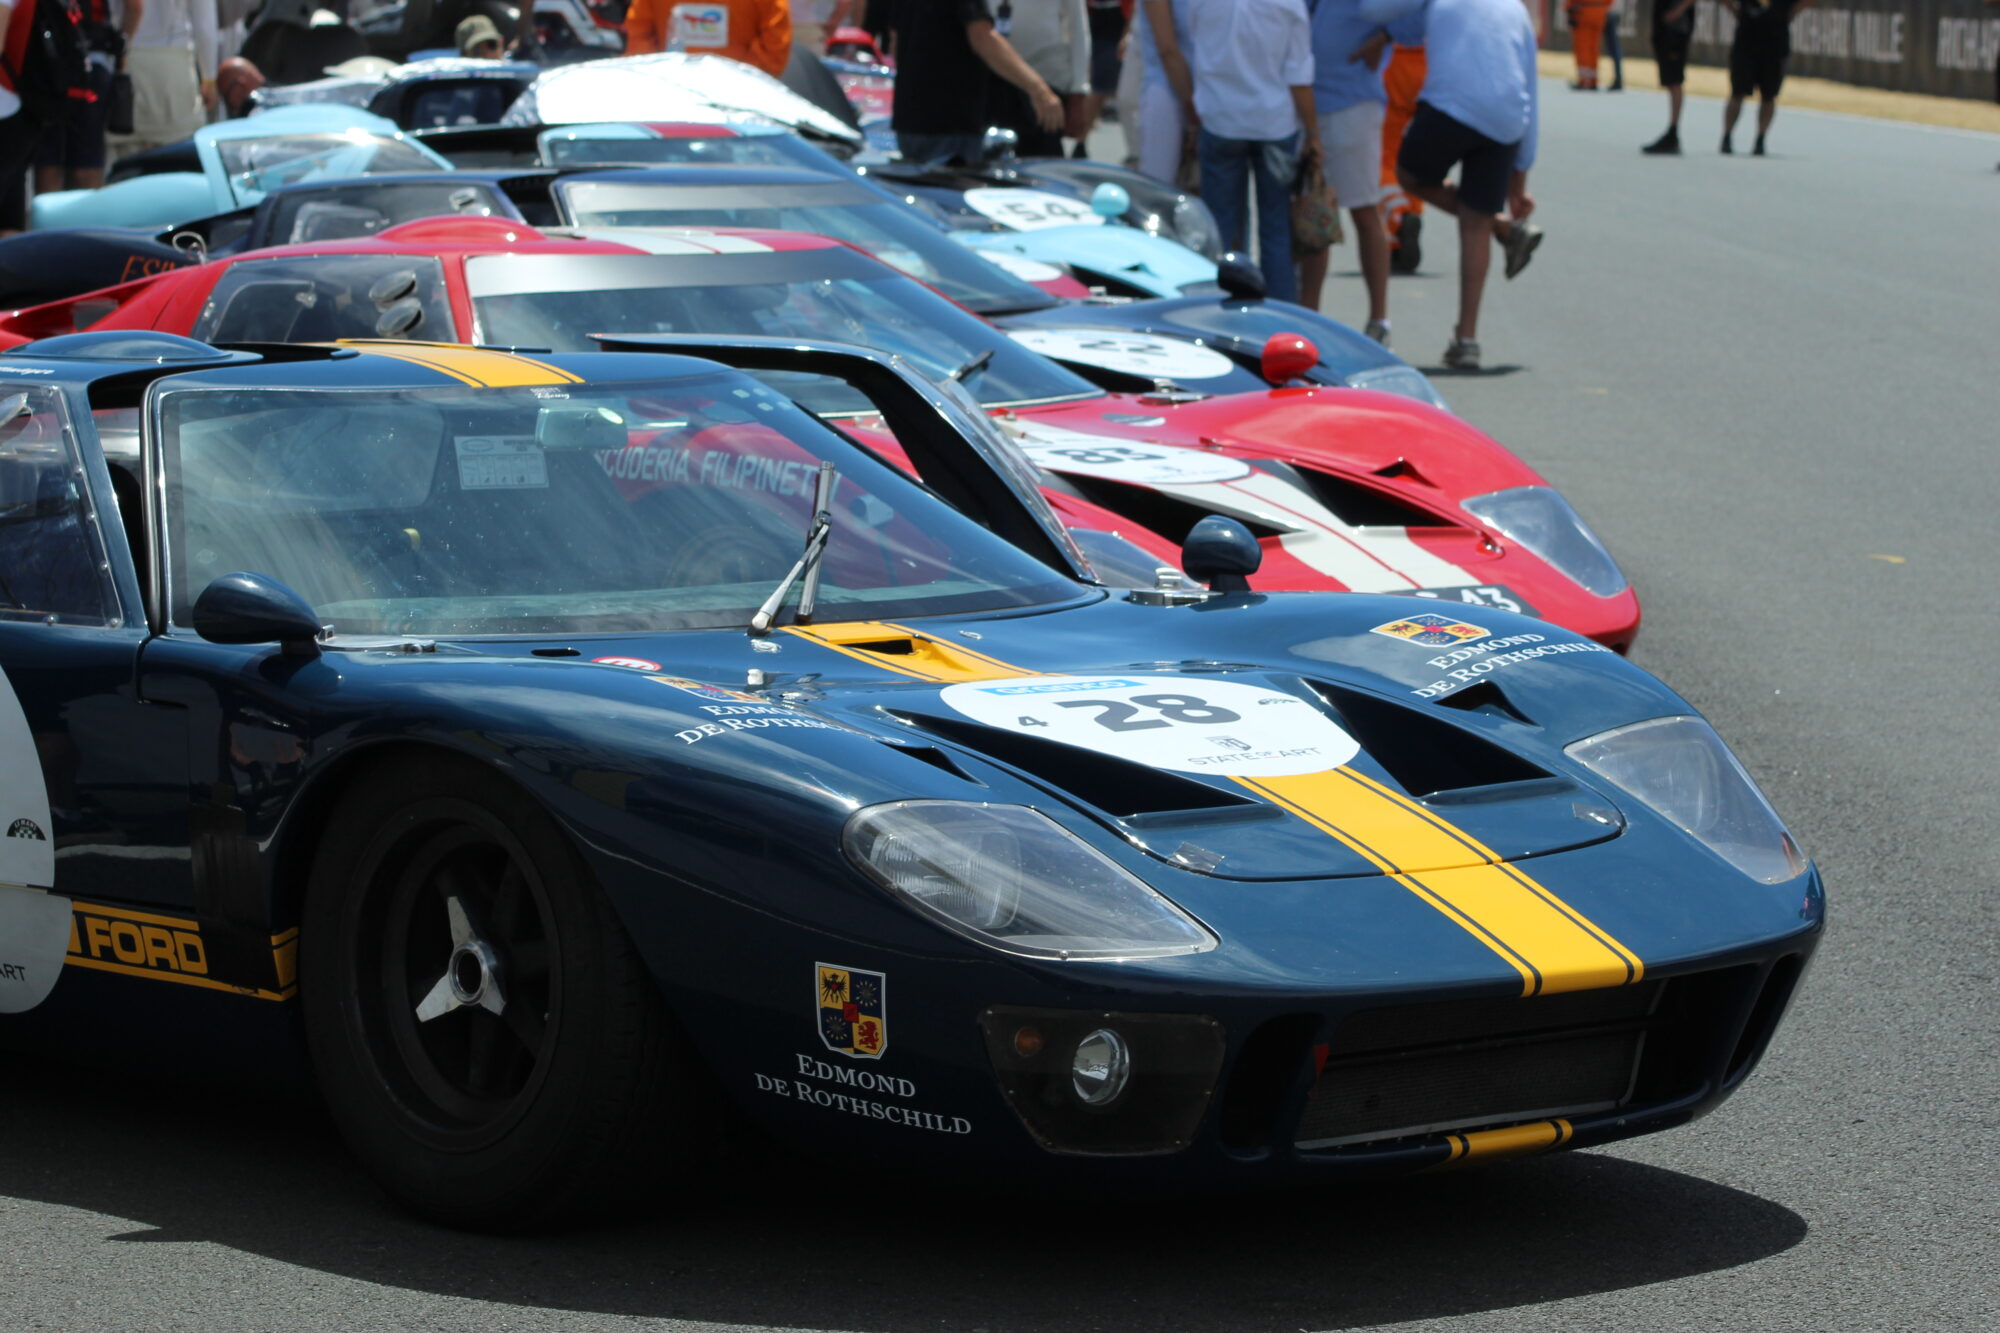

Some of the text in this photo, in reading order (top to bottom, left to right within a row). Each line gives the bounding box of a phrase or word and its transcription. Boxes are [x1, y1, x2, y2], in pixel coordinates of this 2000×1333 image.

[1426, 633, 1546, 670] EDMOND
[1410, 680, 1456, 698] DE
[700, 705, 798, 716] EDMO
[1017, 715, 1049, 727] 4
[1052, 694, 1241, 732] 28
[675, 724, 725, 744] DE
[1188, 752, 1258, 765] STATE
[1279, 747, 1321, 758] ART
[84, 916, 208, 974] FORD
[796, 1053, 915, 1097] EDMOND
[754, 1073, 972, 1134] DE ROTHSCHILD
